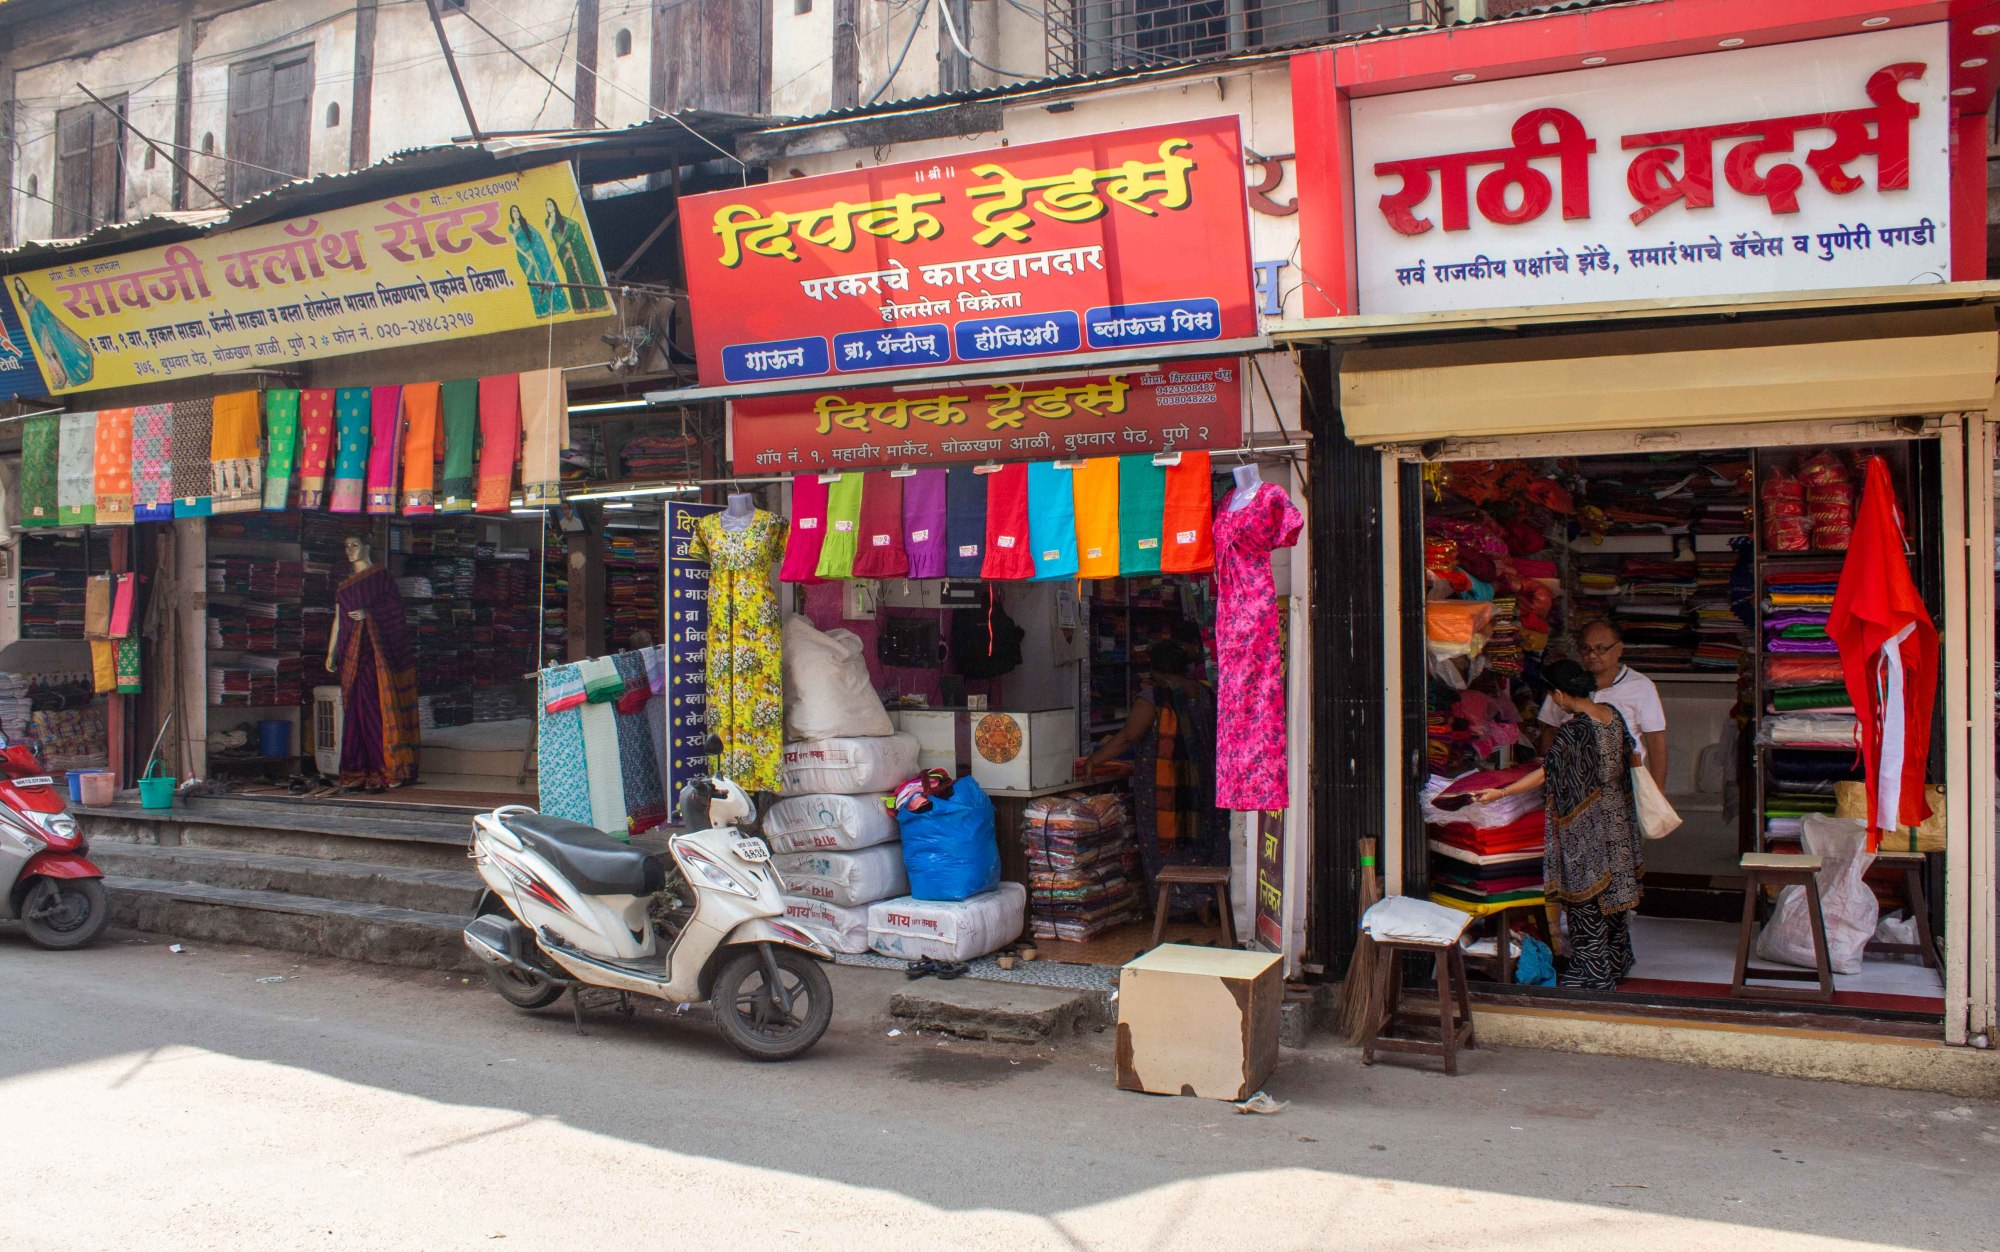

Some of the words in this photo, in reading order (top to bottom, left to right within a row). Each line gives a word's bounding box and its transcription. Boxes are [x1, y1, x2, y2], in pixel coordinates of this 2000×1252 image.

[1374, 107, 1597, 235] राठी
[1621, 62, 1928, 226] ब्रदर्स
[712, 192, 945, 269] दिपक
[966, 138, 1198, 248] ट्रेडर्स
[56, 245, 212, 320] सावजी
[217, 218, 367, 290] क्लॉथ
[374, 197, 508, 263] सेंटर
[1396, 258, 1426, 286] सर्व
[1433, 254, 1506, 285] राजकीय
[1513, 247, 1569, 278] पक्षांचे
[1576, 244, 1619, 275] झेंडे,
[1628, 235, 1722, 269] समारंभाचे
[1729, 230, 1783, 259] बॅचेस
[1792, 234, 1809, 253] व
[1817, 223, 1871, 261] पुणेरी
[1878, 217, 1935, 247] पगडी
[800, 259, 911, 301] परकरचे
[917, 245, 1105, 287] कारखानदार
[98, 334, 120, 354] वार,
[126, 329, 149, 352] वार,
[267, 308, 279, 326] व
[278, 303, 305, 323] बस्ता
[304, 291, 345, 322] होलसेल
[344, 290, 377, 311] भावात
[375, 276, 429, 306] मिळण्याचे
[429, 269, 468, 303] एकमेव
[467, 265, 515, 293] ठिकाण.
[878, 297, 951, 322] होलसेल
[956, 289, 1022, 313] विक्रेता
[1092, 314, 1166, 339] ब्लाऊज
[1171, 308, 1213, 331] पिस
[160, 354, 190, 376] बुधवार
[191, 348, 213, 367] पेठ,
[214, 344, 252, 363] चोळखण
[255, 337, 287, 357] आळी,
[286, 331, 305, 355] पुणे
[309, 335, 317, 348] २
[331, 325, 357, 346] फोन
[843, 341, 873, 361] ब्रा,
[974, 321, 1060, 352] होजिअरी
[744, 346, 805, 371] गाऊन
[813, 395, 969, 435] दिपक
[985, 373, 1132, 431] ट्रेडर्स
[756, 448, 781, 465] शॉप
[787, 447, 803, 464] नं.
[832, 442, 880, 463] महावीर
[886, 440, 934, 458] मार्केट,
[941, 437, 1003, 456] चोळखण
[1009, 430, 1056, 451] आळी,
[1064, 427, 1116, 452] बुधवार
[1123, 426, 1153, 445] पेठ,
[1162, 423, 1190, 446] पुणे
[1199, 426, 1209, 441] २
[685, 610, 700, 622] ब्रा
[1264, 832, 1278, 863] ब्रा
[787, 906, 810, 918] गाय
[888, 913, 910, 927] गाय
